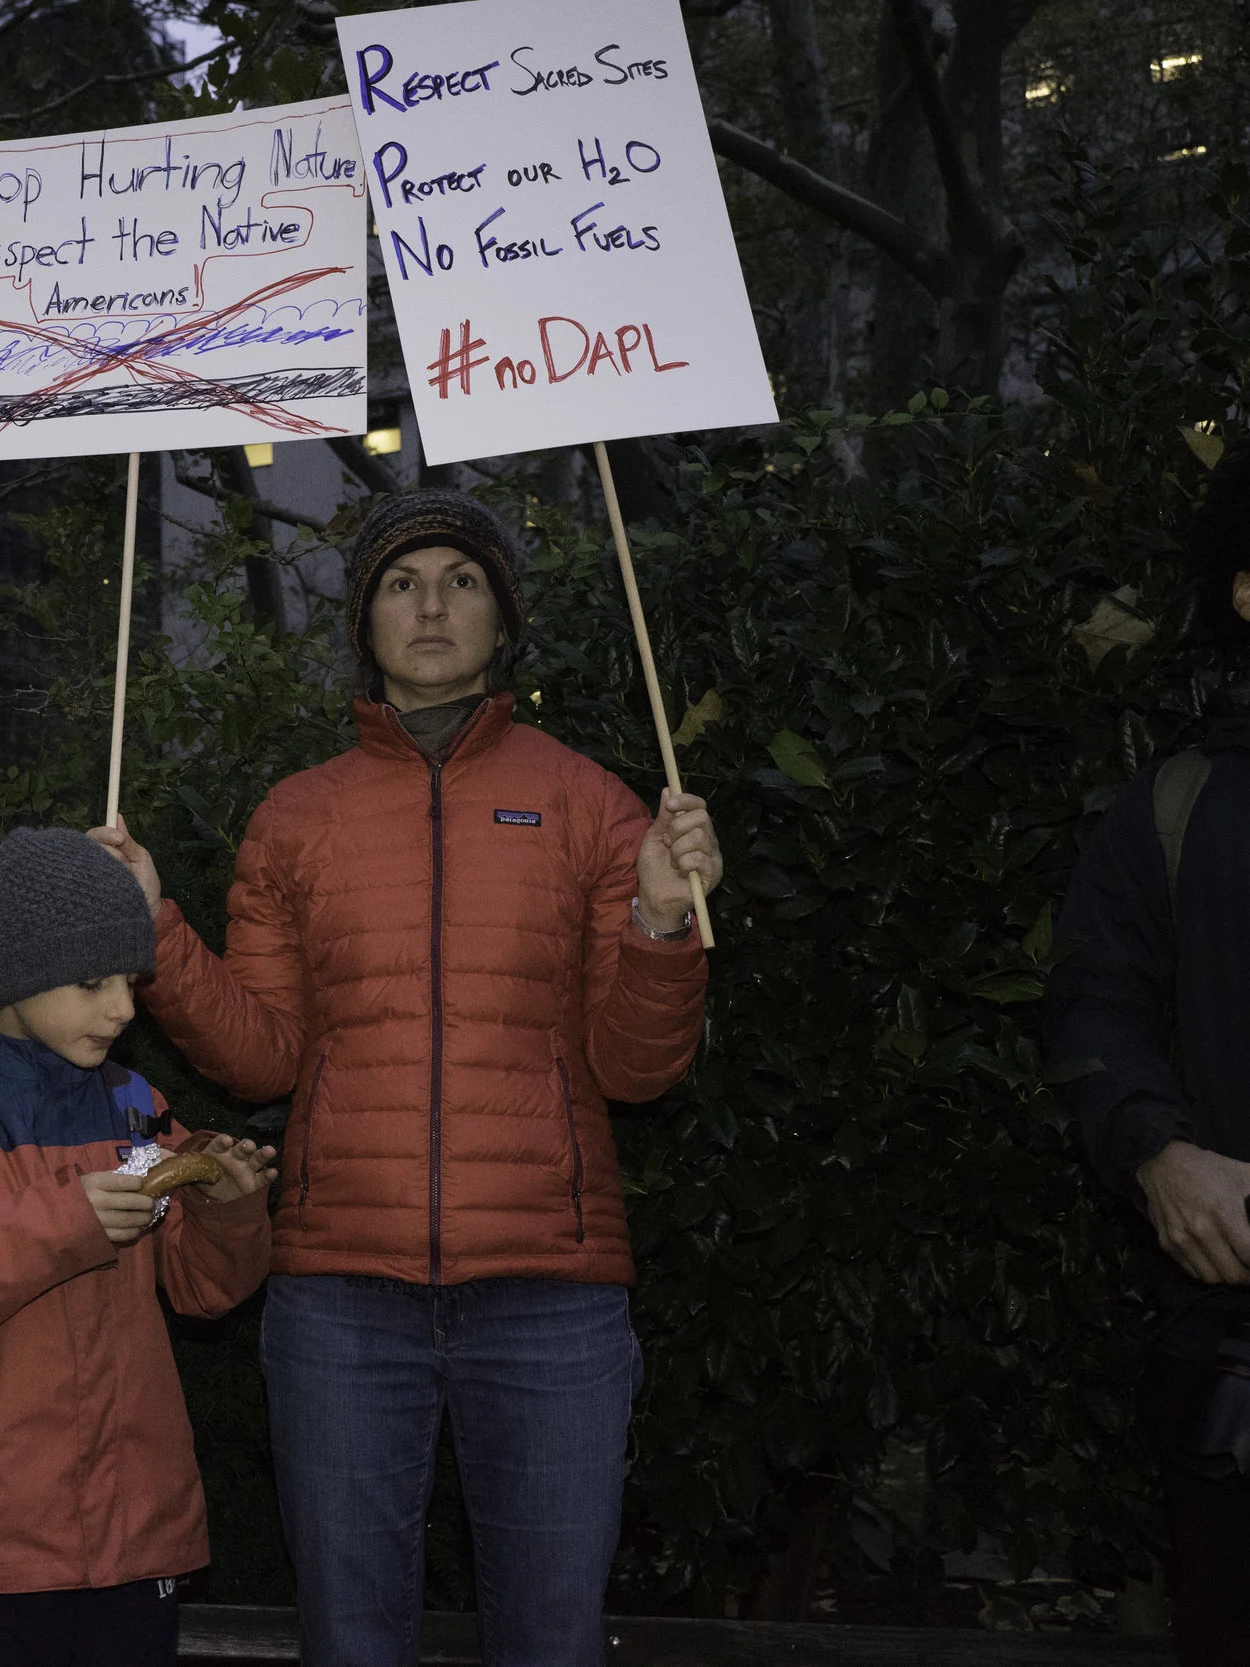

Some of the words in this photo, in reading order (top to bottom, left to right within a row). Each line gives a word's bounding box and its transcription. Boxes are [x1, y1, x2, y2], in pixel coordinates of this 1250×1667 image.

[356, 44, 500, 116] RESPECT
[510, 46, 593, 96] SACRED
[594, 43, 669, 85] SITES
[80, 131, 246, 209] Hurting
[373, 141, 487, 208] PROTECT
[578, 137, 661, 186] H2O
[112, 215, 178, 262] the
[200, 196, 301, 251] Native
[475, 206, 563, 268] FOSSIL
[571, 202, 661, 252] FUELS
[43, 263, 200, 316] Americans!
[427, 316, 690, 400] #noDAPL
[500, 816, 536, 824] patagonia
